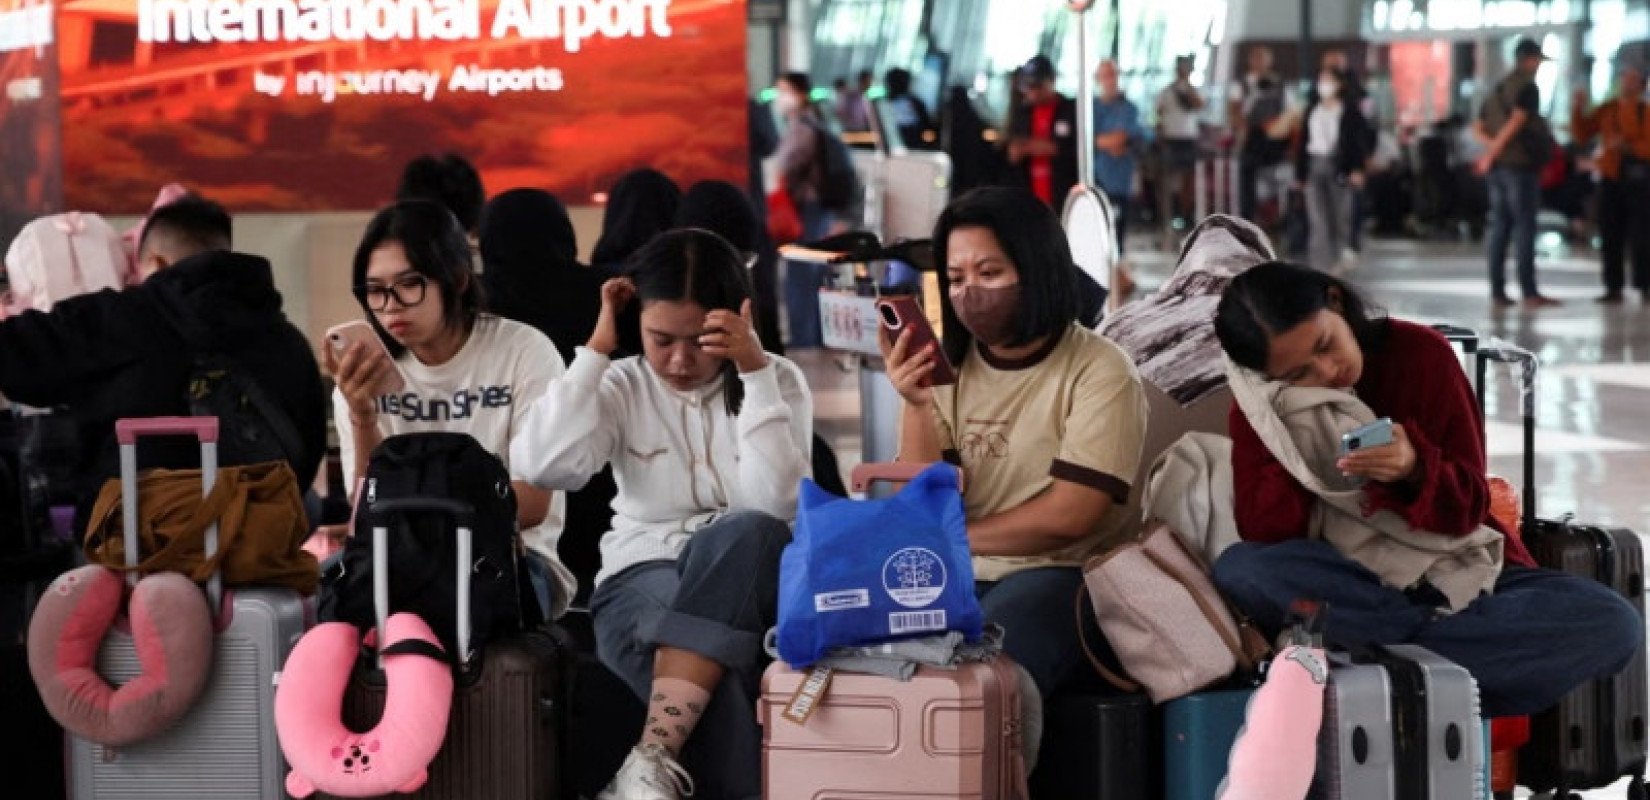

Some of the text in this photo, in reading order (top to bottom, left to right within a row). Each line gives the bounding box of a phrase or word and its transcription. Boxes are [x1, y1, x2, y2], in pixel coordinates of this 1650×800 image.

[137, 0, 672, 52] International Airport
[448, 64, 563, 96] Airports
